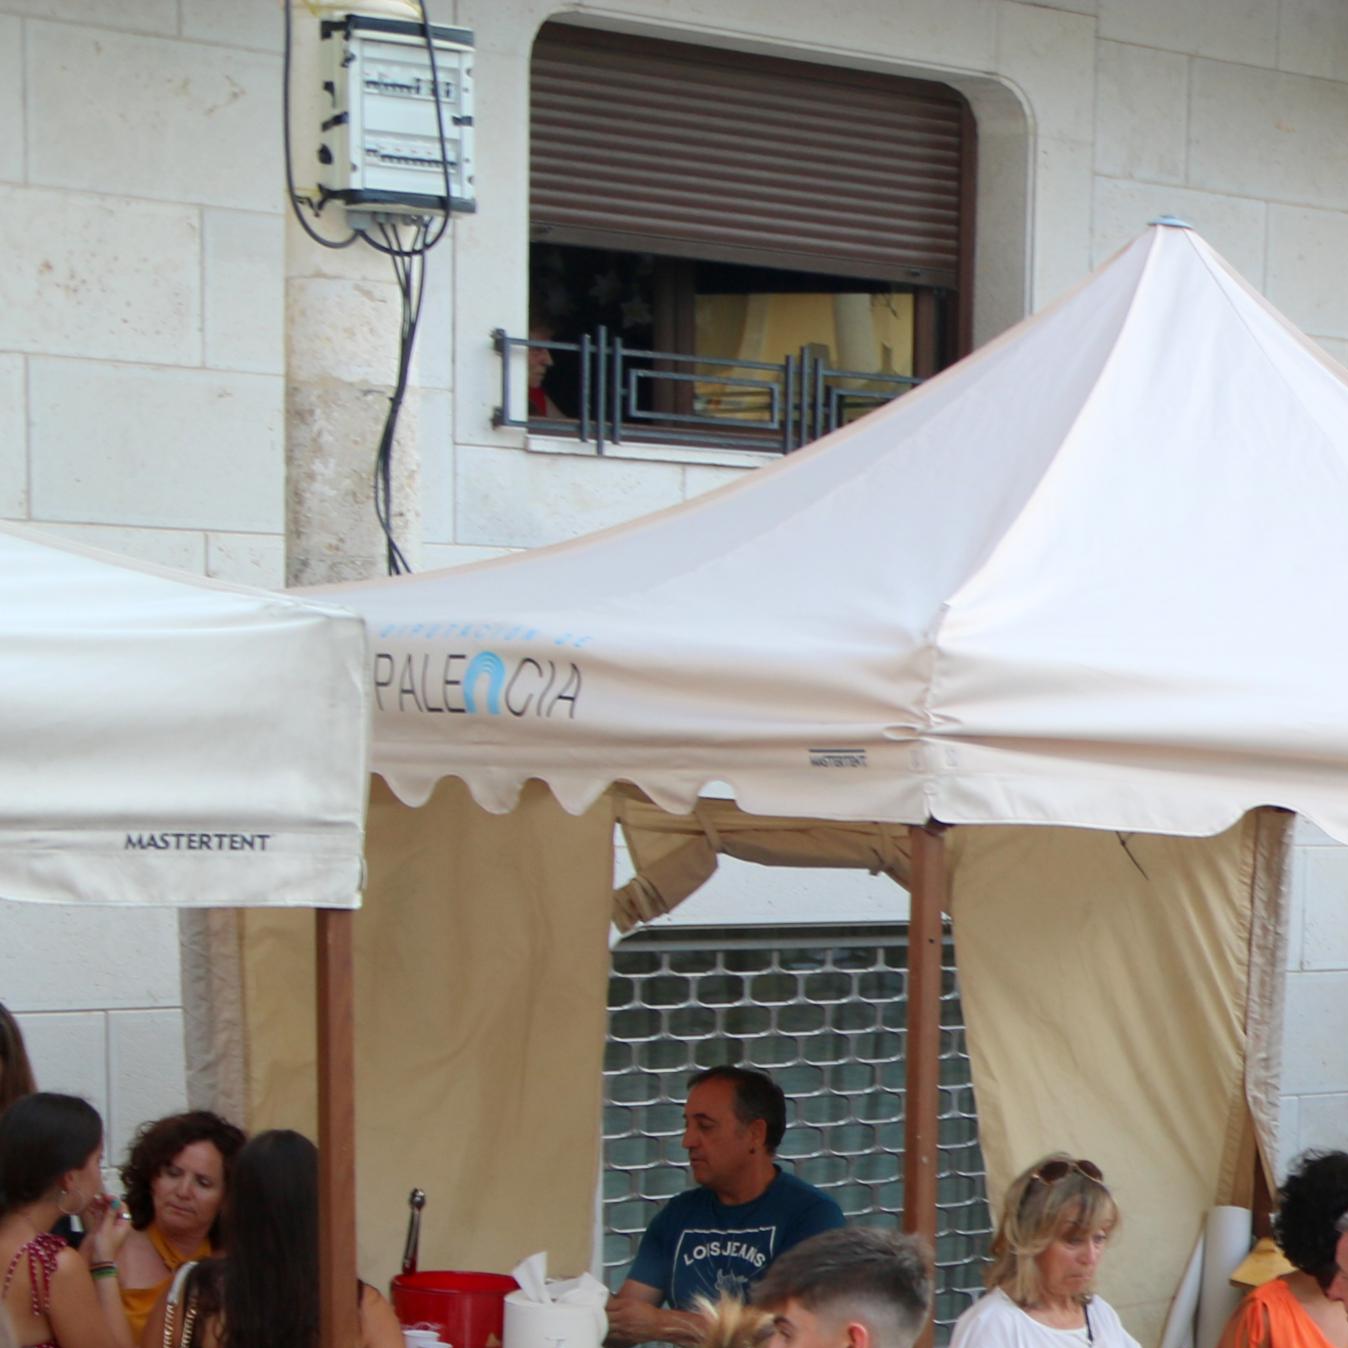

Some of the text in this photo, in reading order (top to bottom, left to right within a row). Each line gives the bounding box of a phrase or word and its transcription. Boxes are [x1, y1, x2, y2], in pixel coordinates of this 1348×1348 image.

[125, 832, 271, 851] MASTERTENT
[684, 1241, 766, 1268] LOIS JEANS
